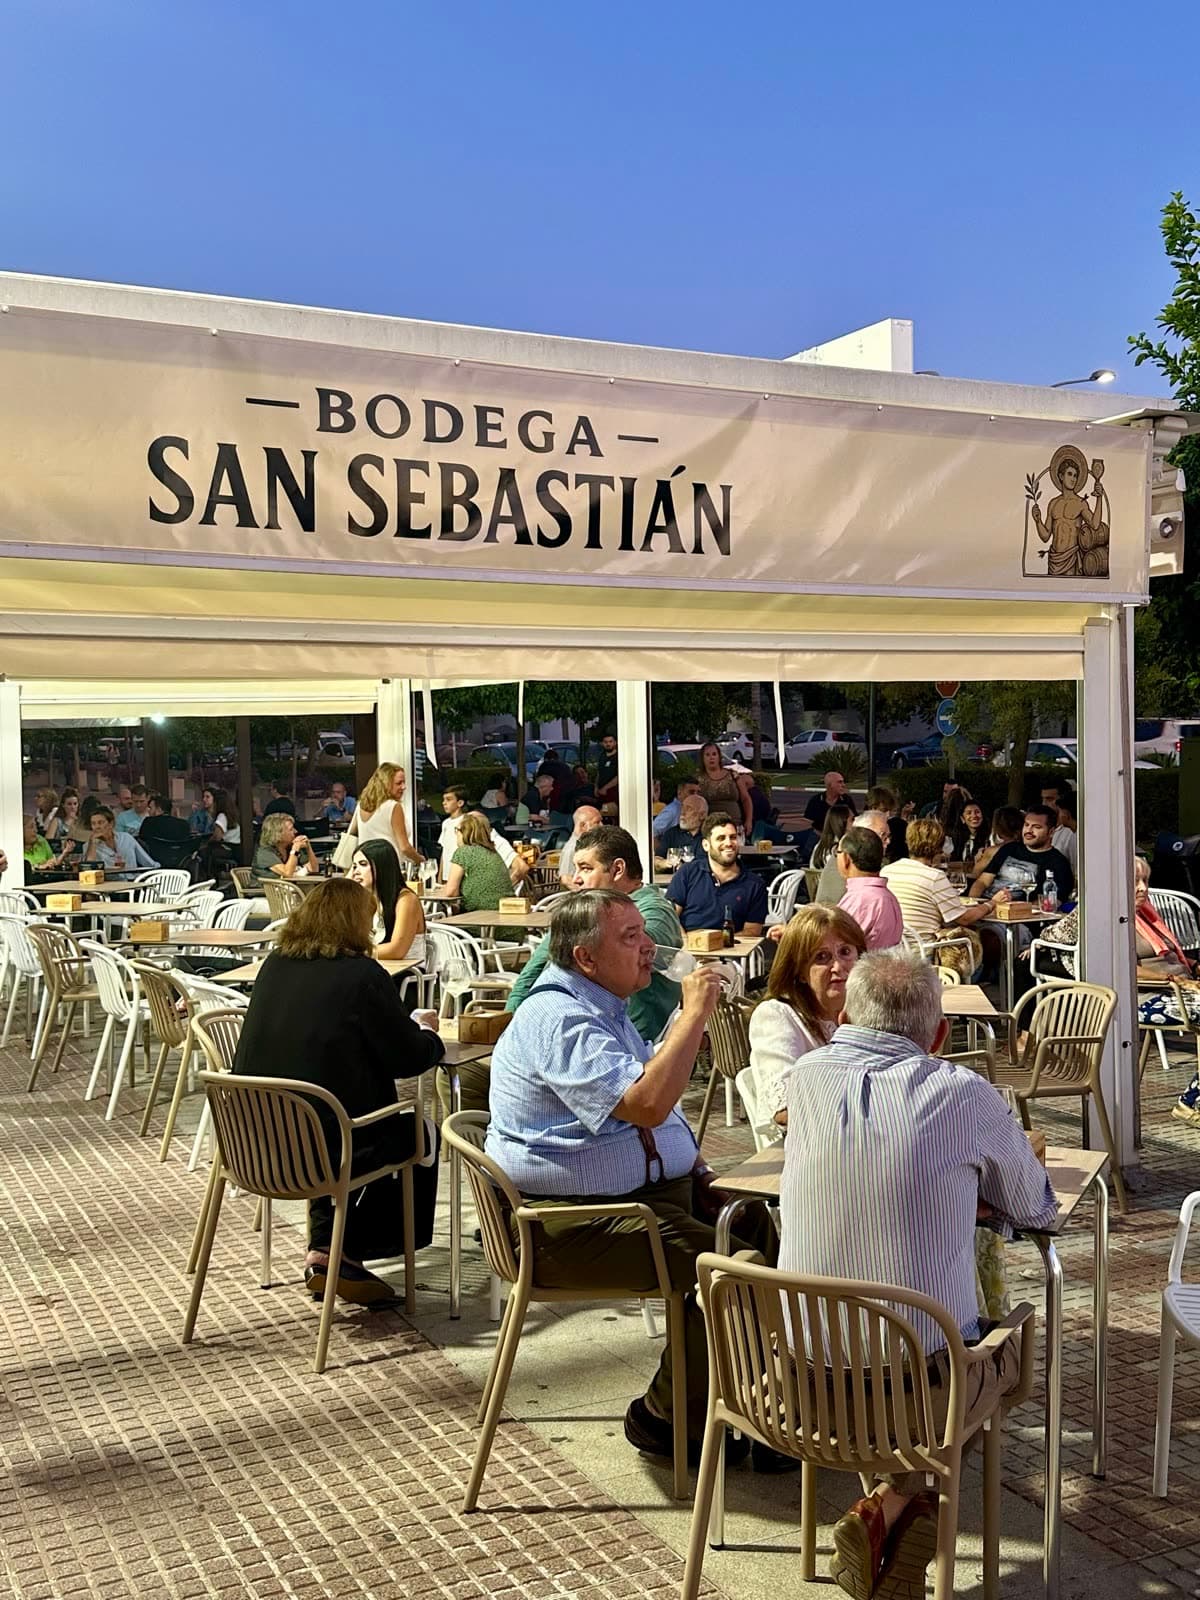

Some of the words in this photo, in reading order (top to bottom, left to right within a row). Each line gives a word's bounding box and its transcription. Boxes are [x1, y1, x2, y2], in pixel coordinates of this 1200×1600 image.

[315, 387, 604, 458] BODEGA
[147, 435, 318, 533] SAN
[347, 453, 733, 556] SEBASTIÁN
